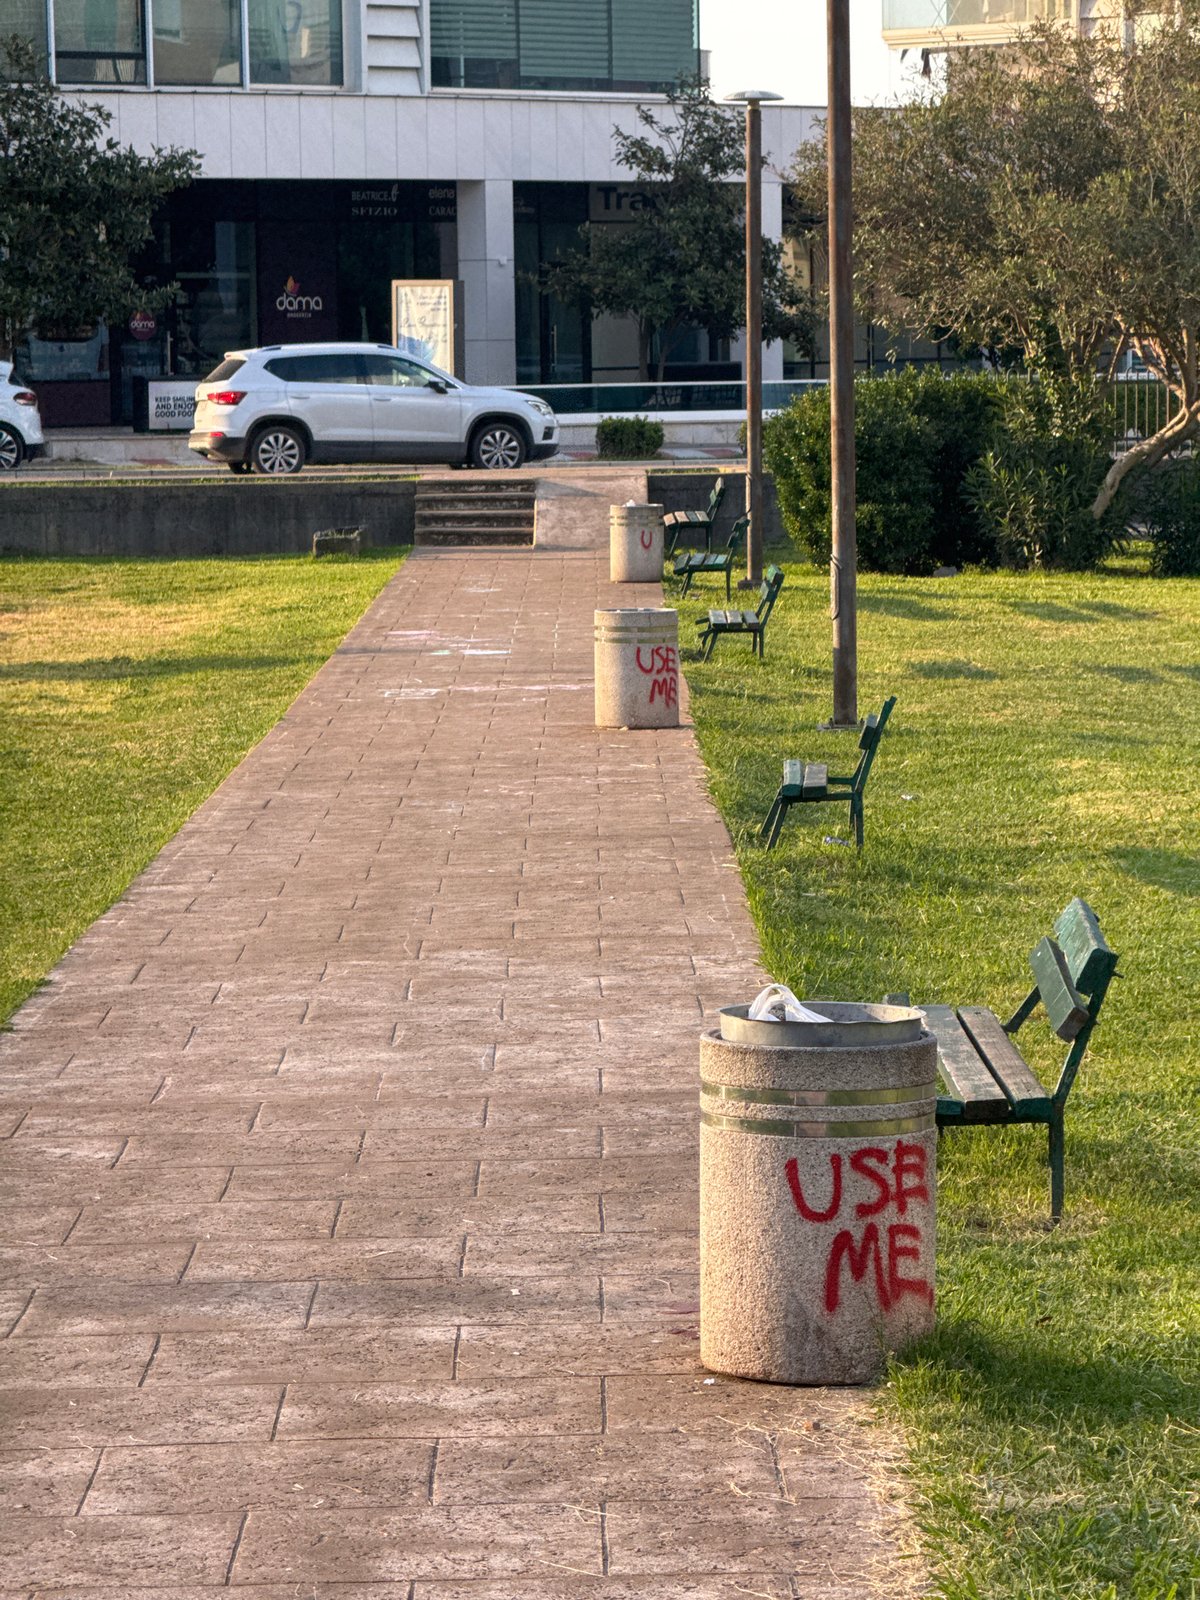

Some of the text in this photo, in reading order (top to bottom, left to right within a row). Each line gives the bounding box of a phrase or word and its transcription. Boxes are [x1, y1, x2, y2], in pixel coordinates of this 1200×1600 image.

[275, 292, 323, 311] dama
[640, 529, 653, 550] U
[636, 645, 678, 675] USE
[784, 1138, 930, 1224] USE
[823, 1221, 935, 1316] ME
